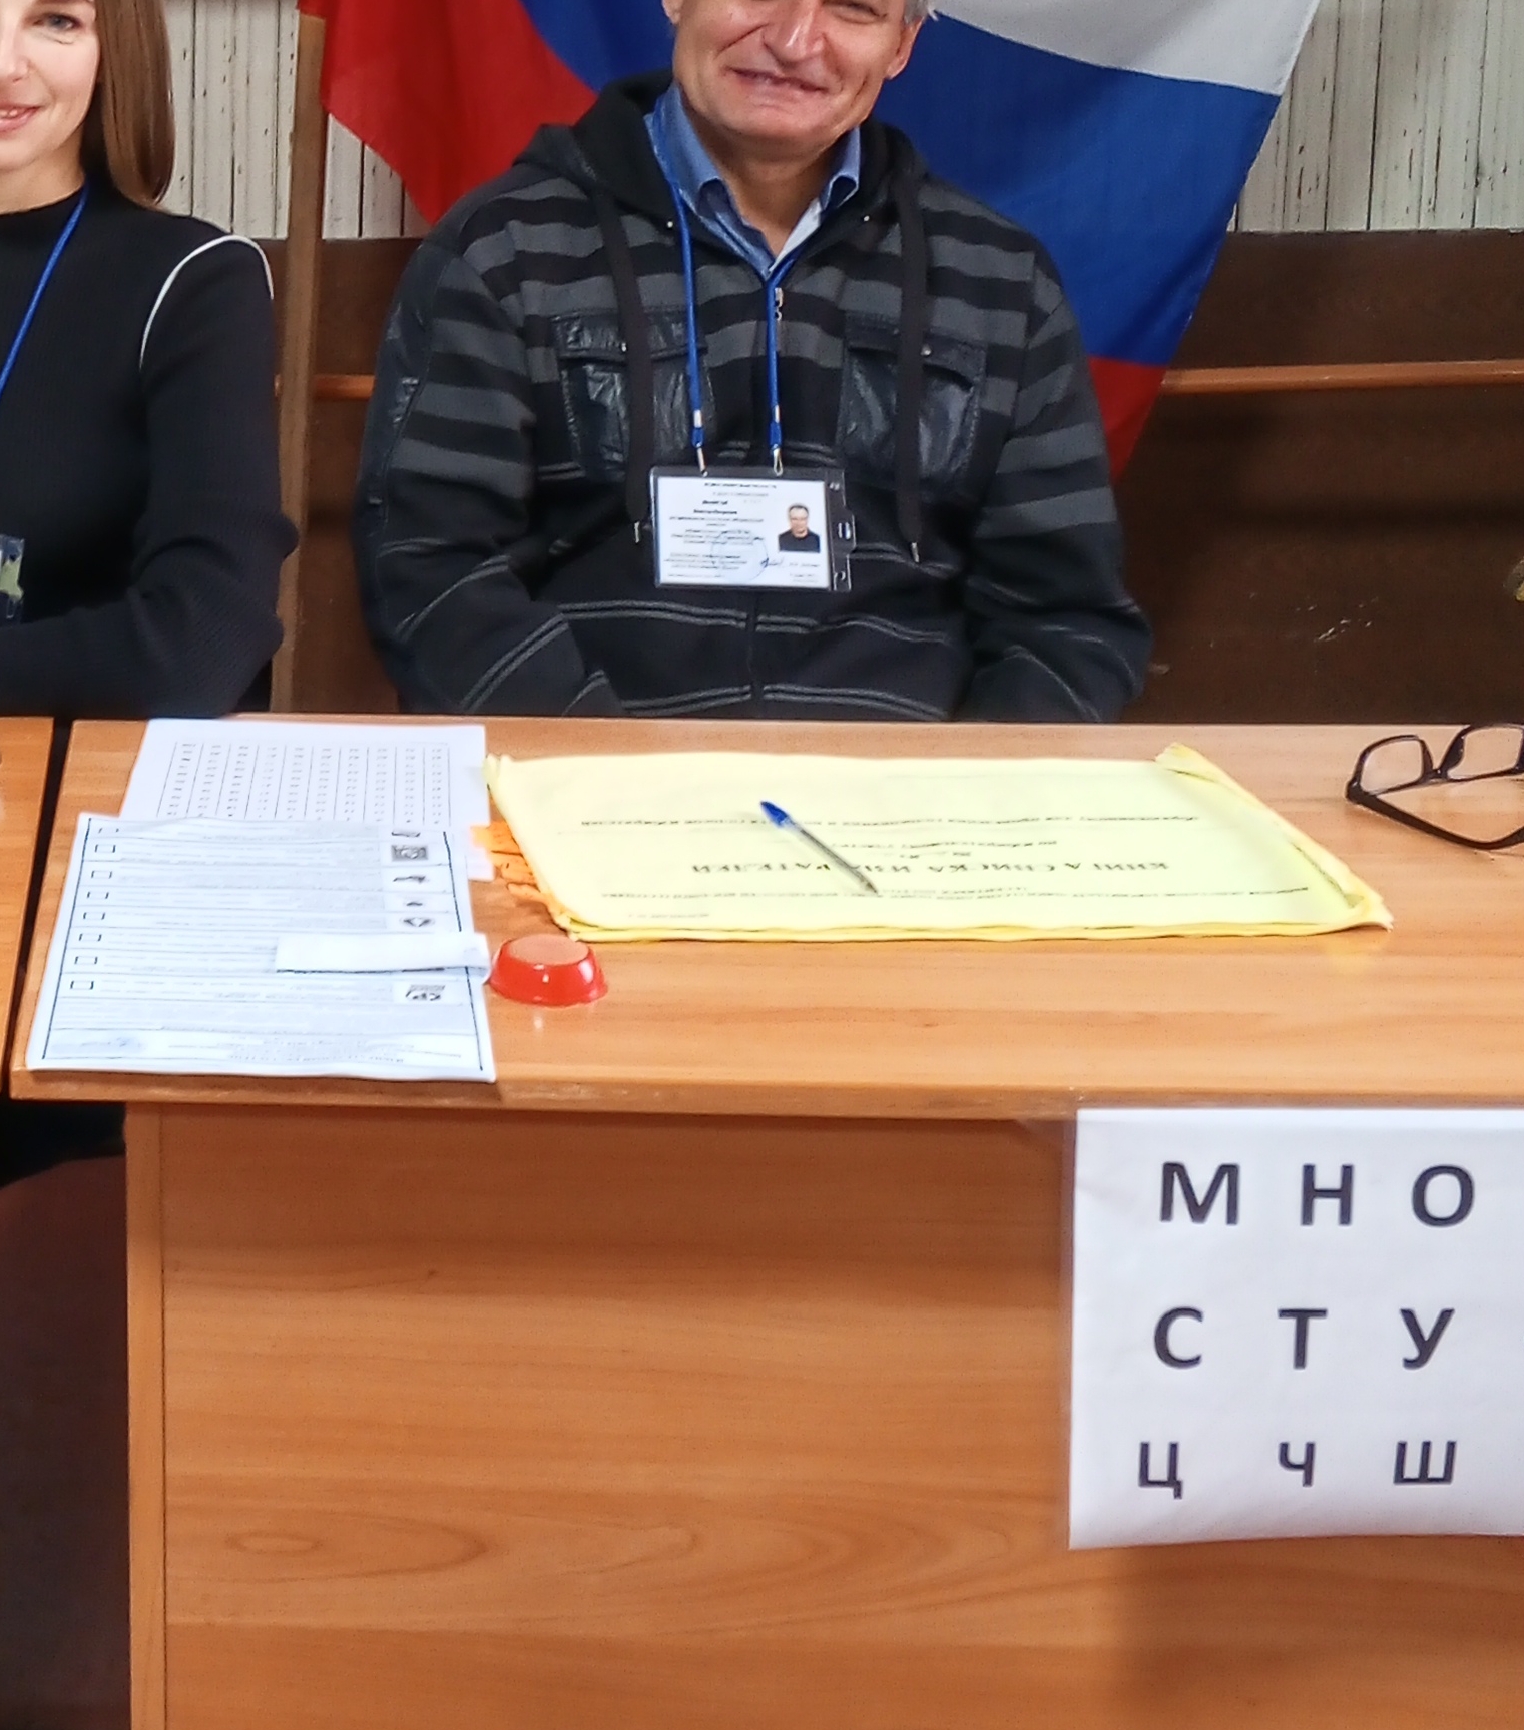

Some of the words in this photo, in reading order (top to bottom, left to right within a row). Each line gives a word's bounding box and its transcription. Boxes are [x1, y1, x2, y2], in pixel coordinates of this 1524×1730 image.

[1161, 1162, 1239, 1224] М
[1302, 1164, 1353, 1225] Н
[1412, 1165, 1474, 1227] О
[1154, 1307, 1202, 1368] С
[1279, 1308, 1327, 1368] Т
[1400, 1308, 1454, 1369] У
[1139, 1442, 1182, 1499] Ц
[1279, 1442, 1315, 1486] Ч
[1393, 1441, 1456, 1484] Ш
